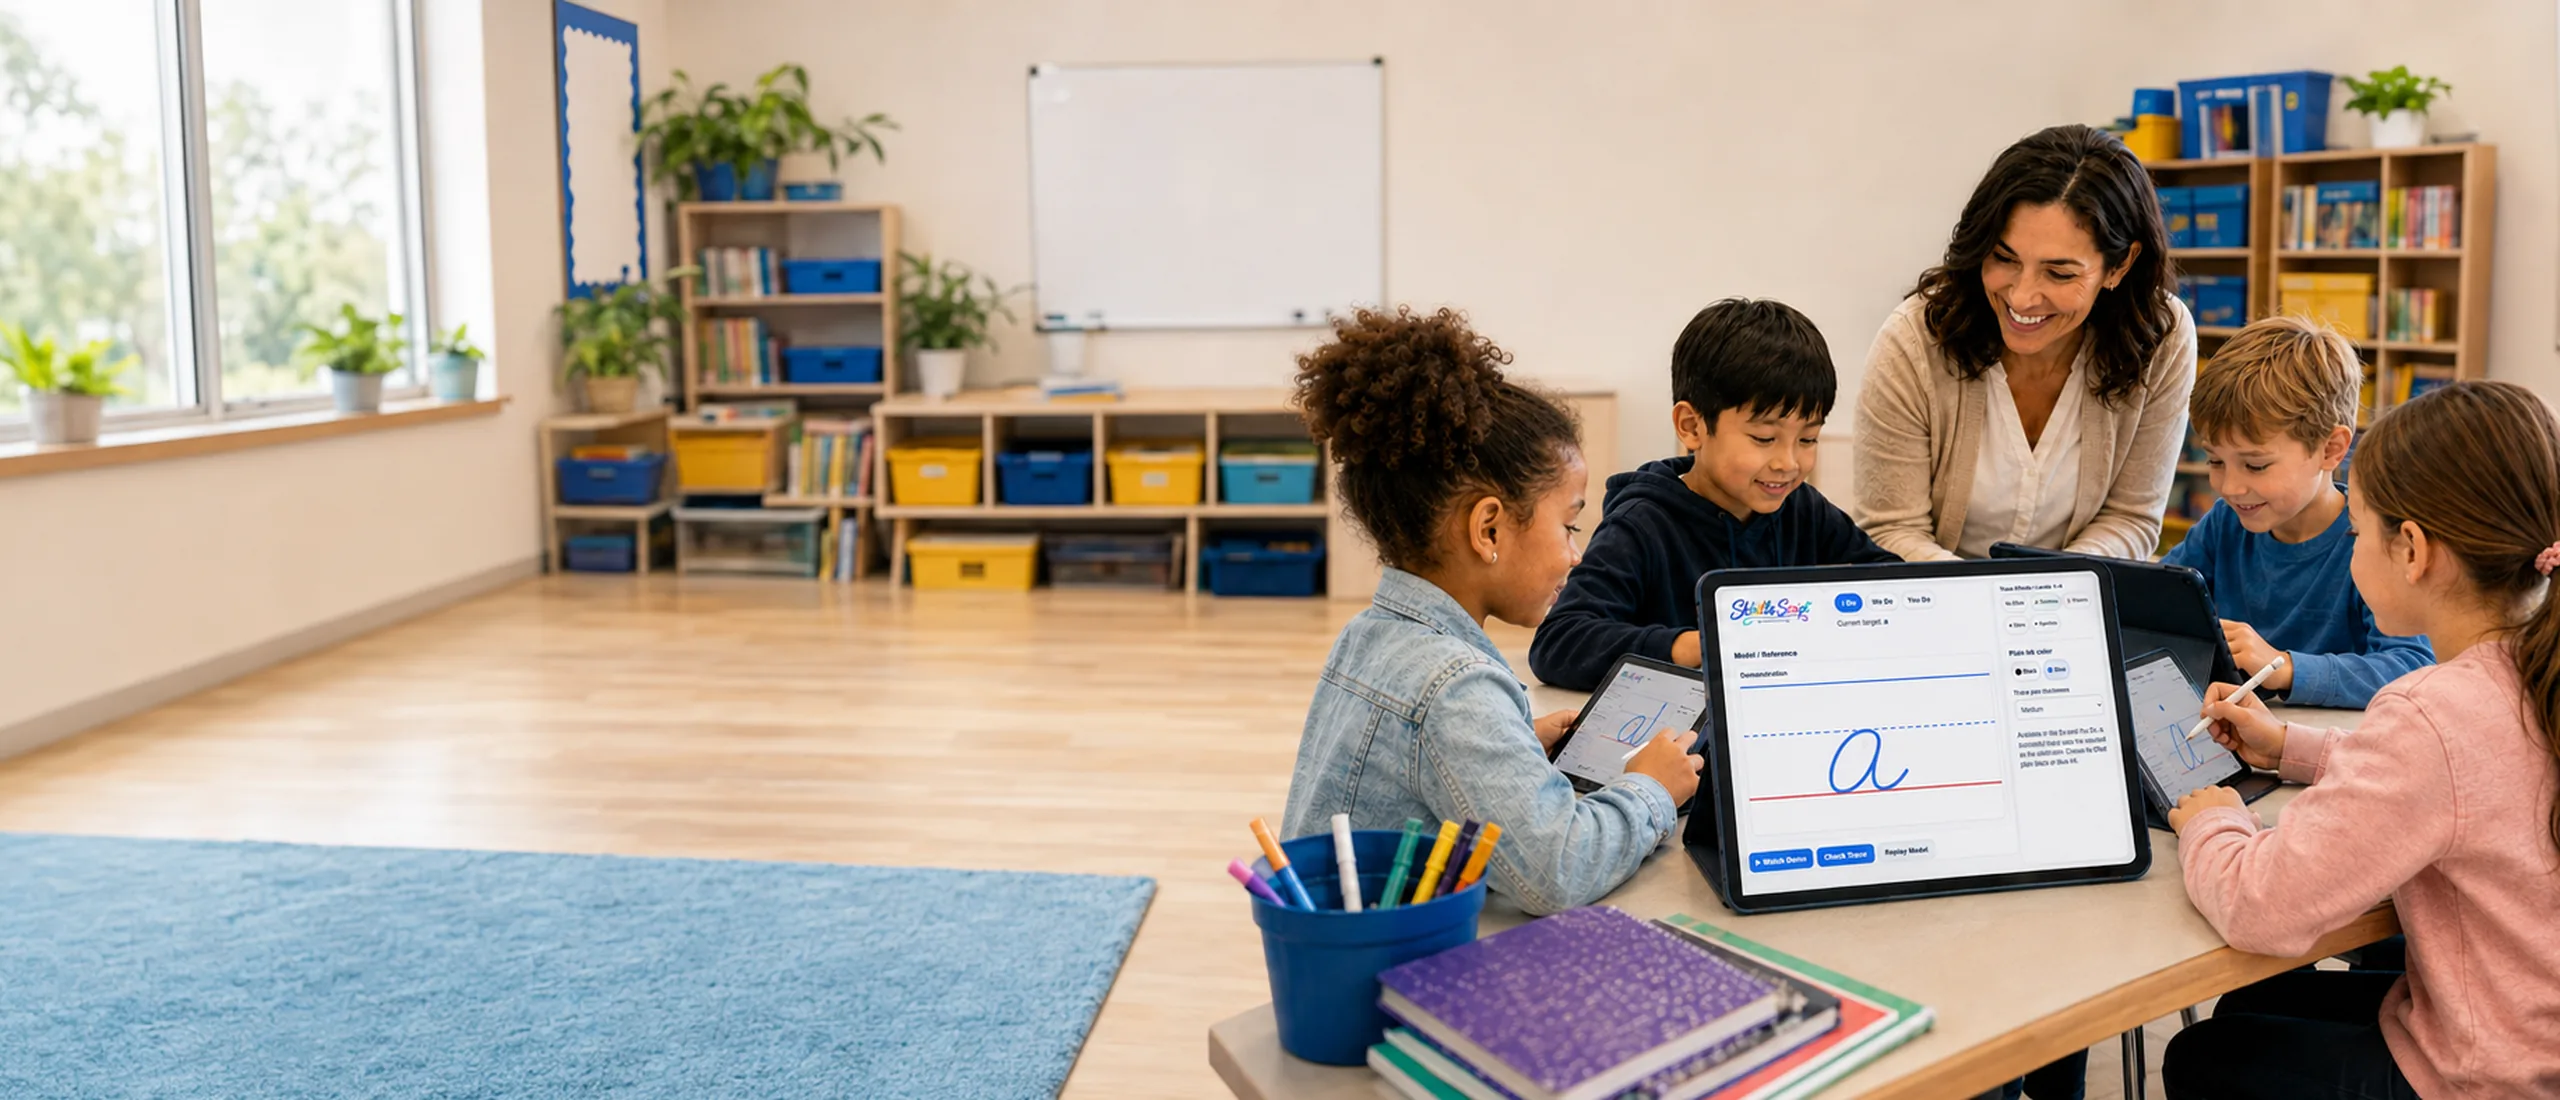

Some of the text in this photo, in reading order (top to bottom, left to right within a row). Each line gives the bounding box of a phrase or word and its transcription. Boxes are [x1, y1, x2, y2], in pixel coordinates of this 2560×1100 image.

[1761, 650, 1798, 658] Reference
[1829, 728, 1909, 793] a
[1885, 849, 1907, 857] Replay
